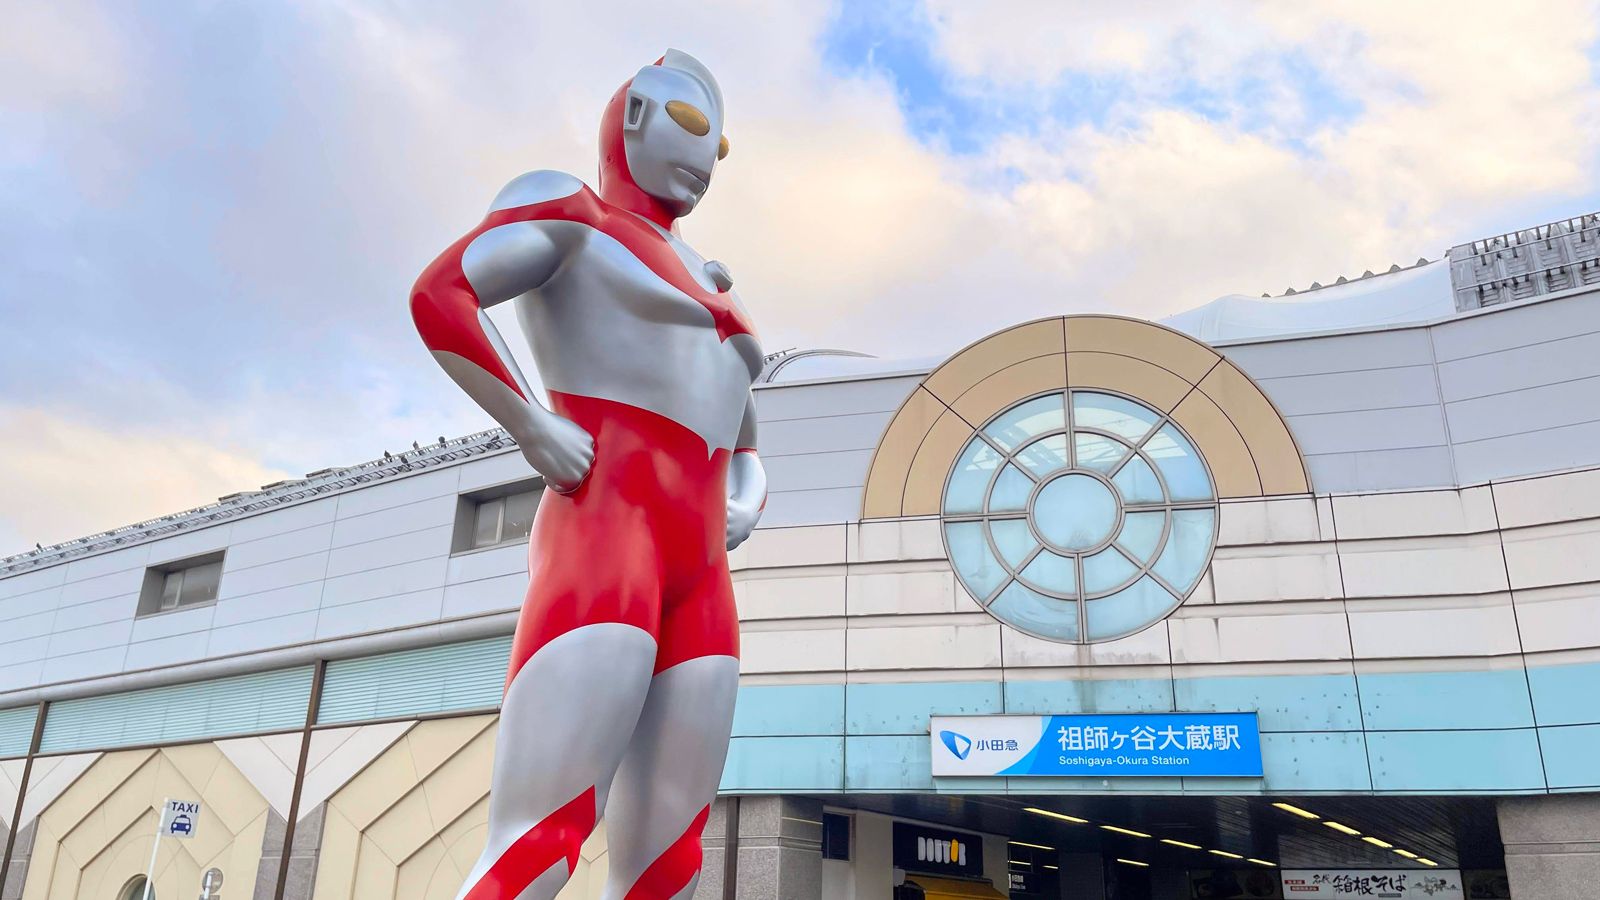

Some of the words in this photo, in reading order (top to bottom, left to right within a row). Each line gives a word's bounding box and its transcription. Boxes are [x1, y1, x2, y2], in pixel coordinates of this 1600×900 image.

[976, 739, 1019, 751] 小田急
[1058, 755, 1149, 766] Soshigaya-Okura
[1151, 755, 1190, 765] Station
[172, 802, 199, 813] TAXI
[917, 836, 966, 866] DOUTOR
[1332, 874, 1407, 895] 箱根そば
